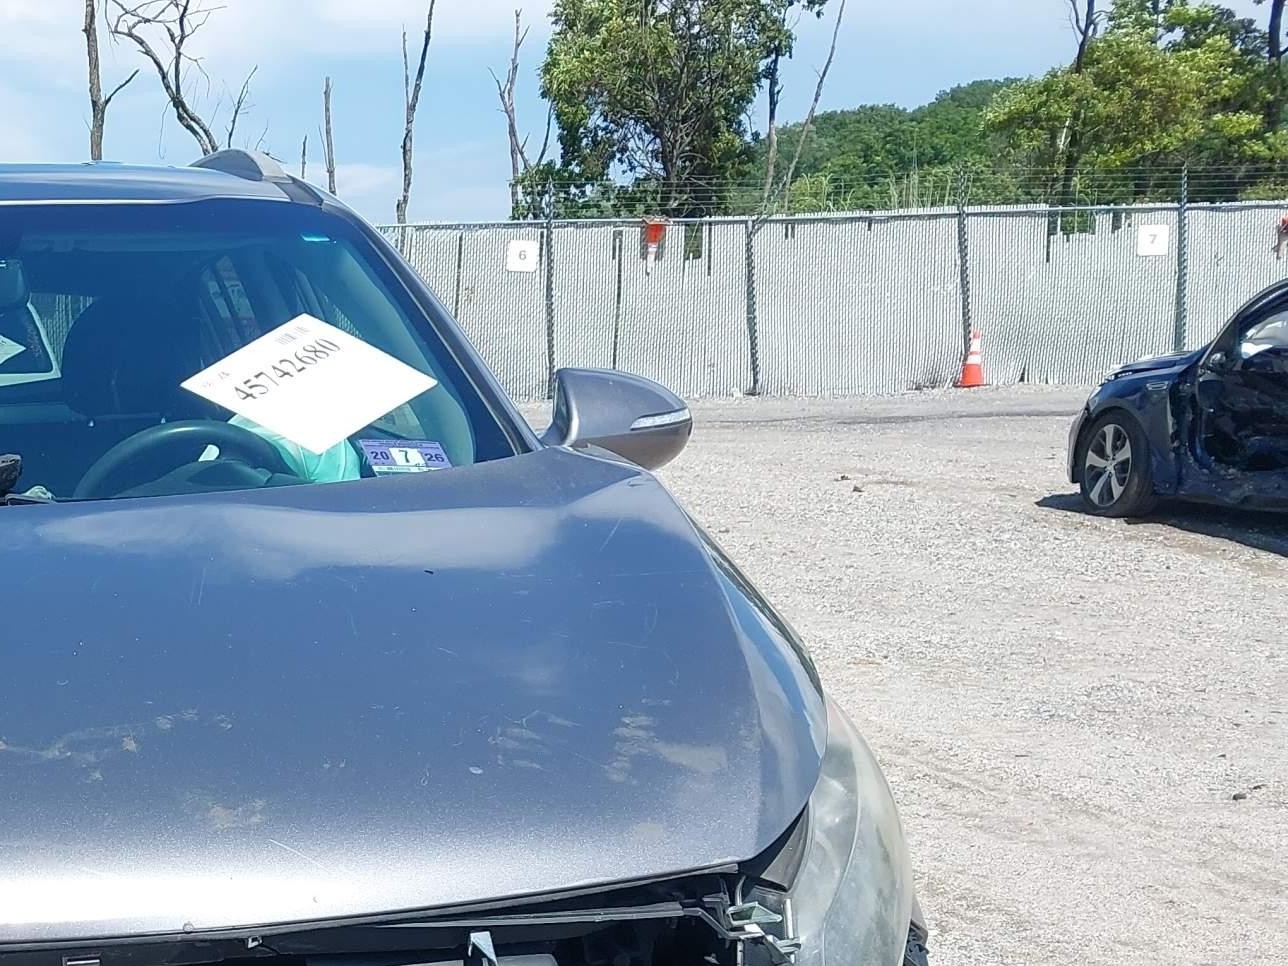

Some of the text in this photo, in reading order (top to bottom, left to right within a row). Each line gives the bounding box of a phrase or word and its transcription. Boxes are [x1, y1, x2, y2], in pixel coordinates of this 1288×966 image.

[1148, 234, 1158, 244] 7
[518, 250, 527, 261] 6
[233, 338, 341, 401] 45742680
[370, 449, 445, 463] 20 7 26
